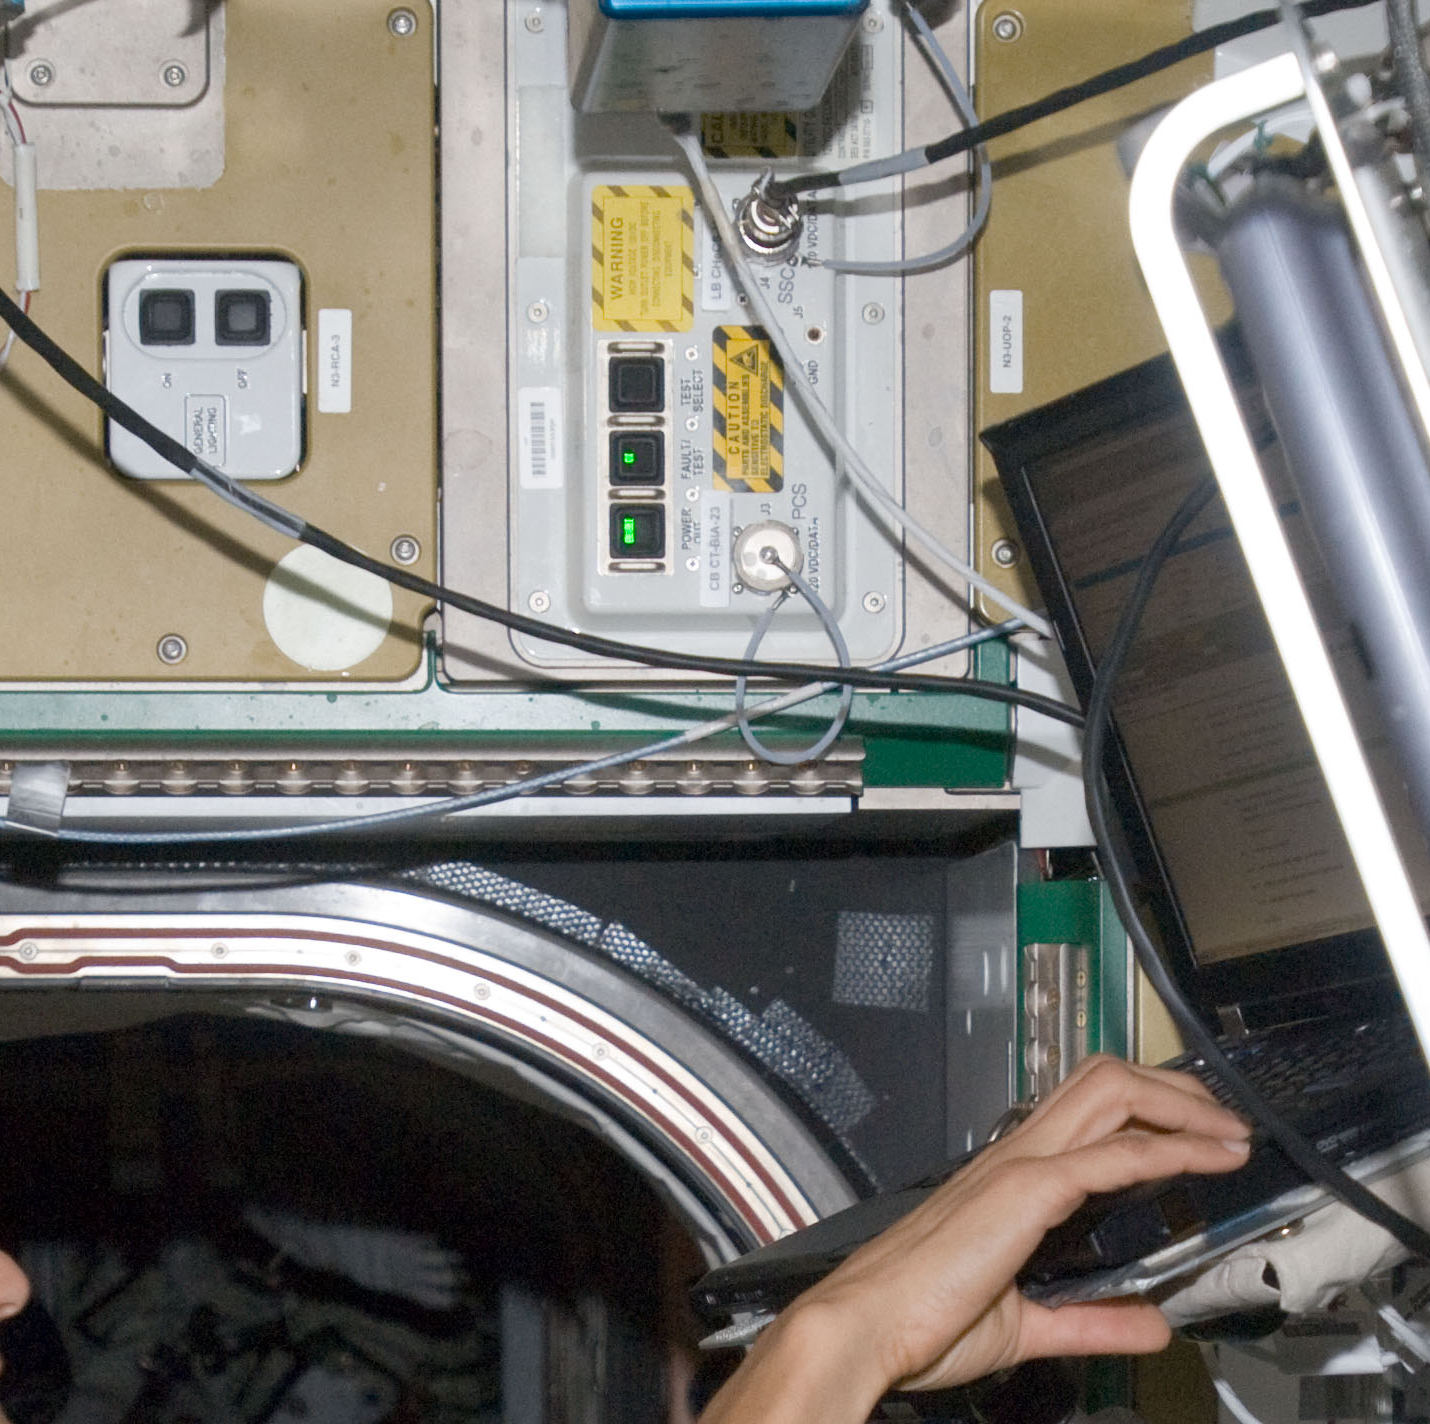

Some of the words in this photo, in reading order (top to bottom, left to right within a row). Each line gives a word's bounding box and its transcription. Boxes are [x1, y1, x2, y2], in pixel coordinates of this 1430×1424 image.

[610, 216, 624, 300] WARNING
[711, 284, 722, 300] LB
[759, 276, 770, 290] J4
[778, 267, 795, 305] SSC
[792, 305, 803, 319] J5
[1002, 314, 1013, 368] N3-UOP-2
[162, 372, 173, 389] ON
[236, 368, 248, 389] OFF
[807, 359, 819, 385] GND
[681, 378, 691, 407] TEST
[693, 369, 704, 413] SELECT
[193, 407, 204, 455] GENERAL
[728, 380, 741, 456] CAUTION
[693, 448, 704, 477] TEST
[760, 502, 771, 515] J3
[791, 482, 807, 520] PCS
[681, 507, 692, 550] POWER
[709, 572, 721, 591] CB
